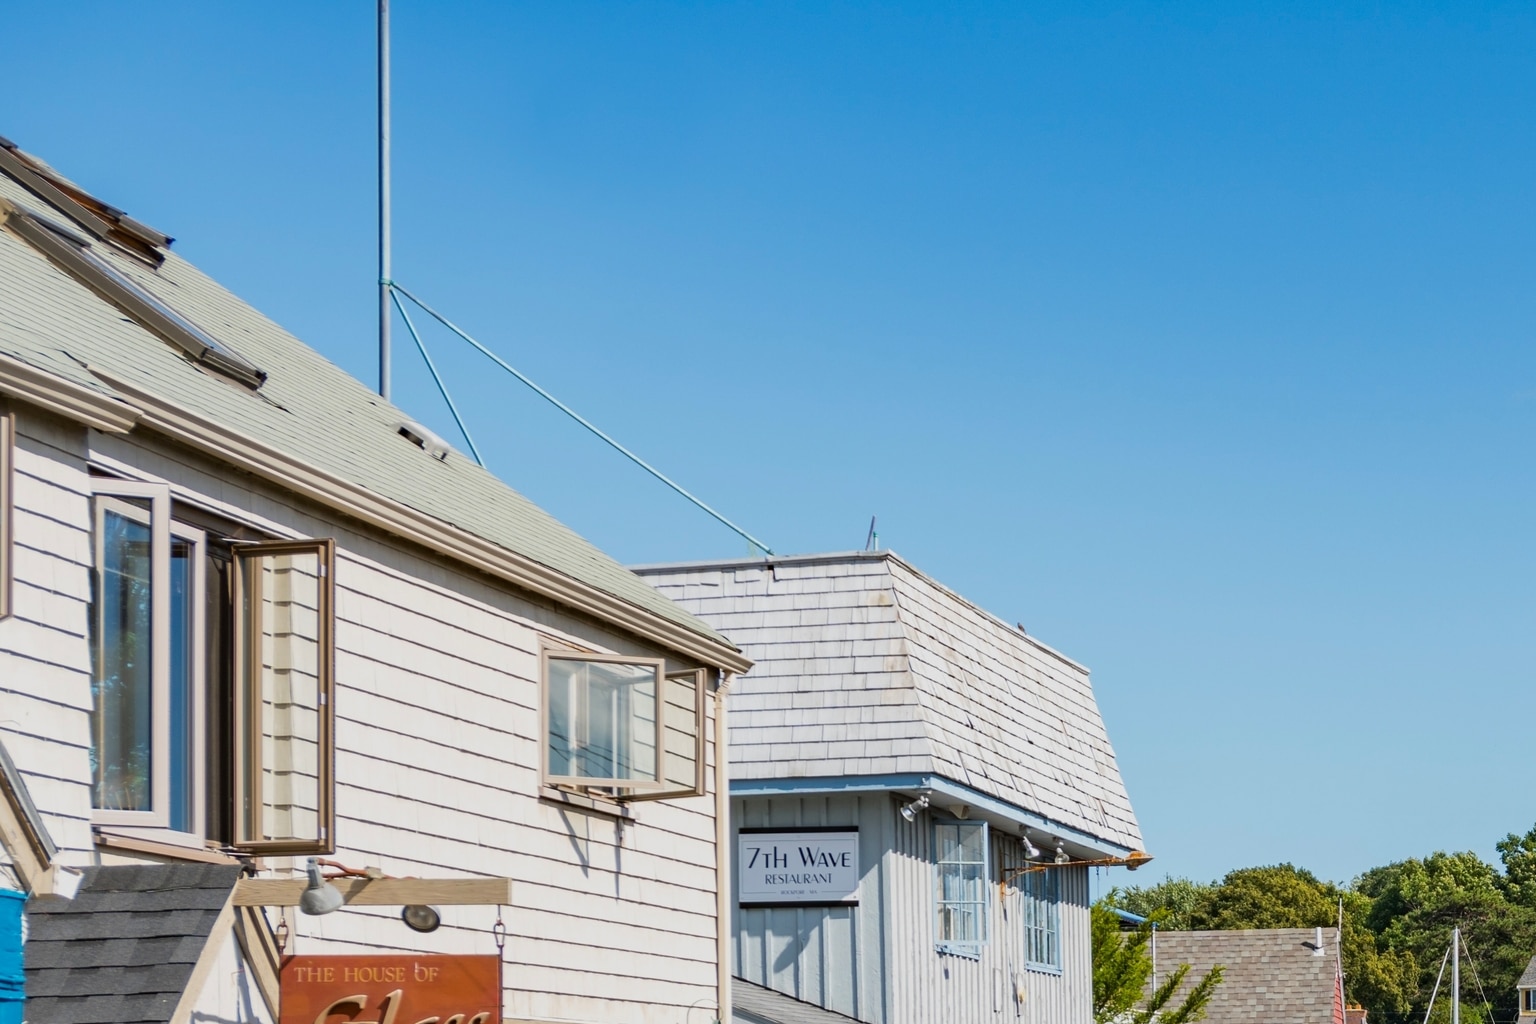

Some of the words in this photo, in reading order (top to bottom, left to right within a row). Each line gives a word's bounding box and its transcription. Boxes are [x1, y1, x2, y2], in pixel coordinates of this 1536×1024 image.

[765, 873, 832, 885] RESTAURANT
[293, 966, 335, 983] THE
[344, 966, 406, 983] HOUSE
[414, 967, 440, 983] OF
